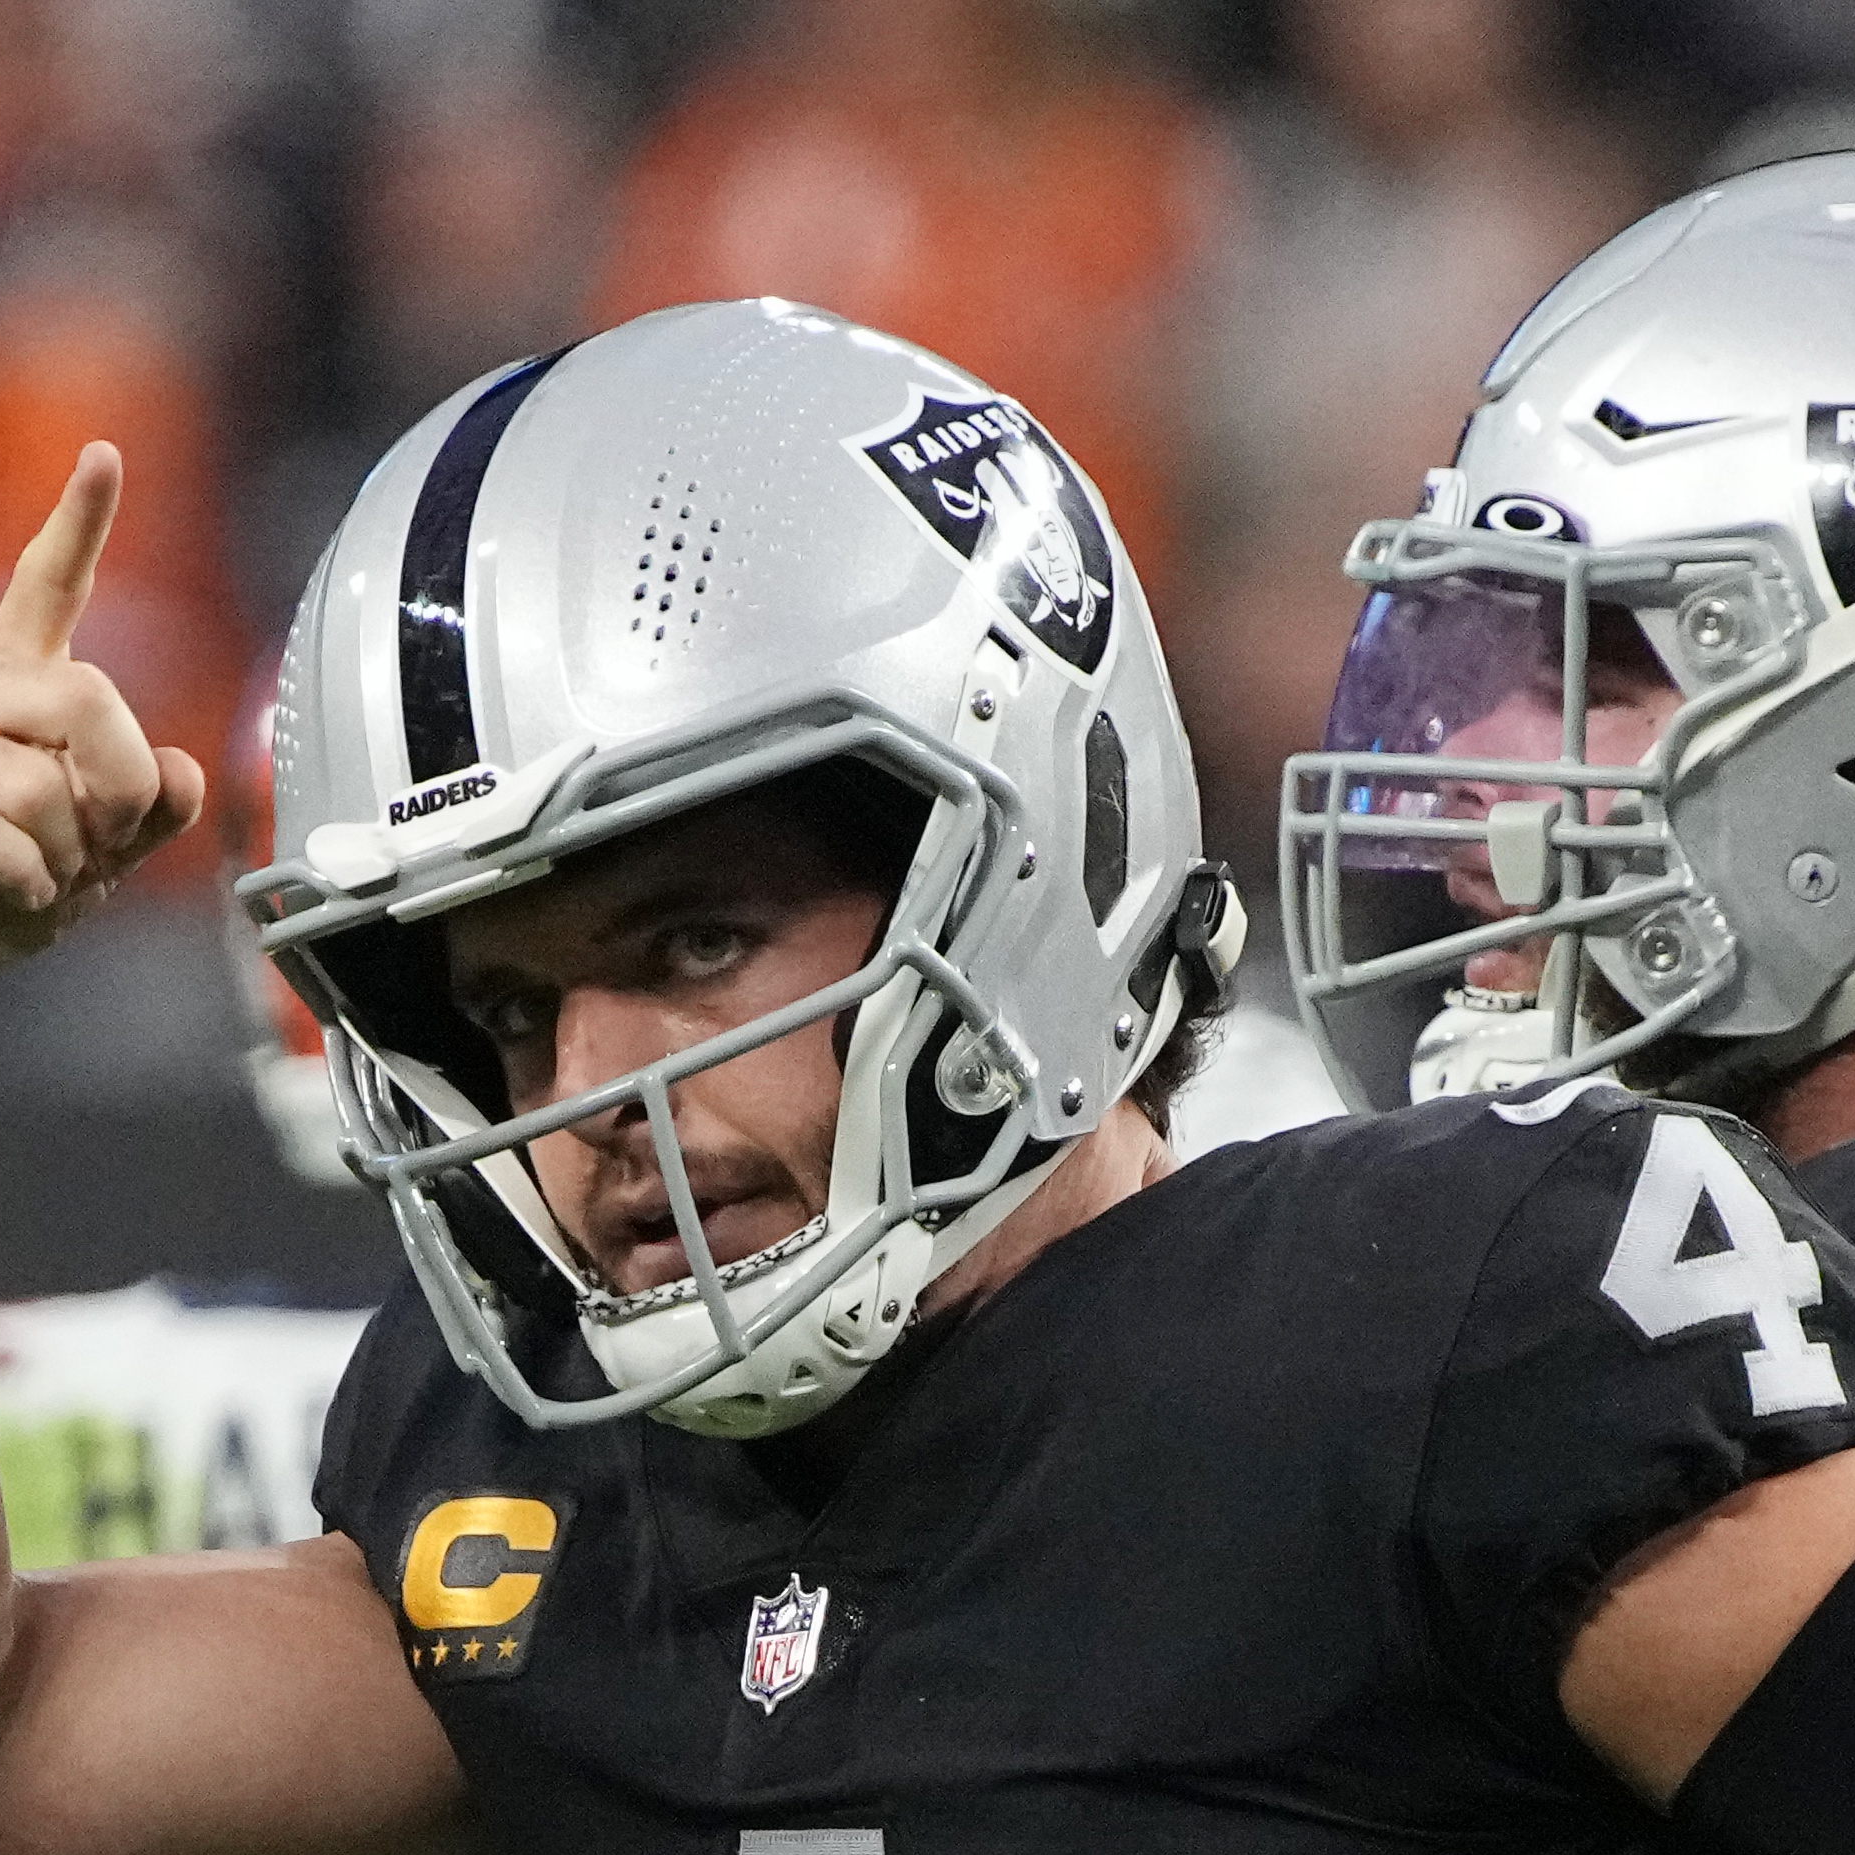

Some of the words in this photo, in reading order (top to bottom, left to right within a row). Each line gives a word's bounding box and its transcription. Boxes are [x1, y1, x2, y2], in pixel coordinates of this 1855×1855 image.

[388, 770, 498, 827] RAIDERS
[1600, 1114, 1848, 1416] 4
[402, 1496, 558, 1629] C
[752, 1634, 799, 1687] NFL
